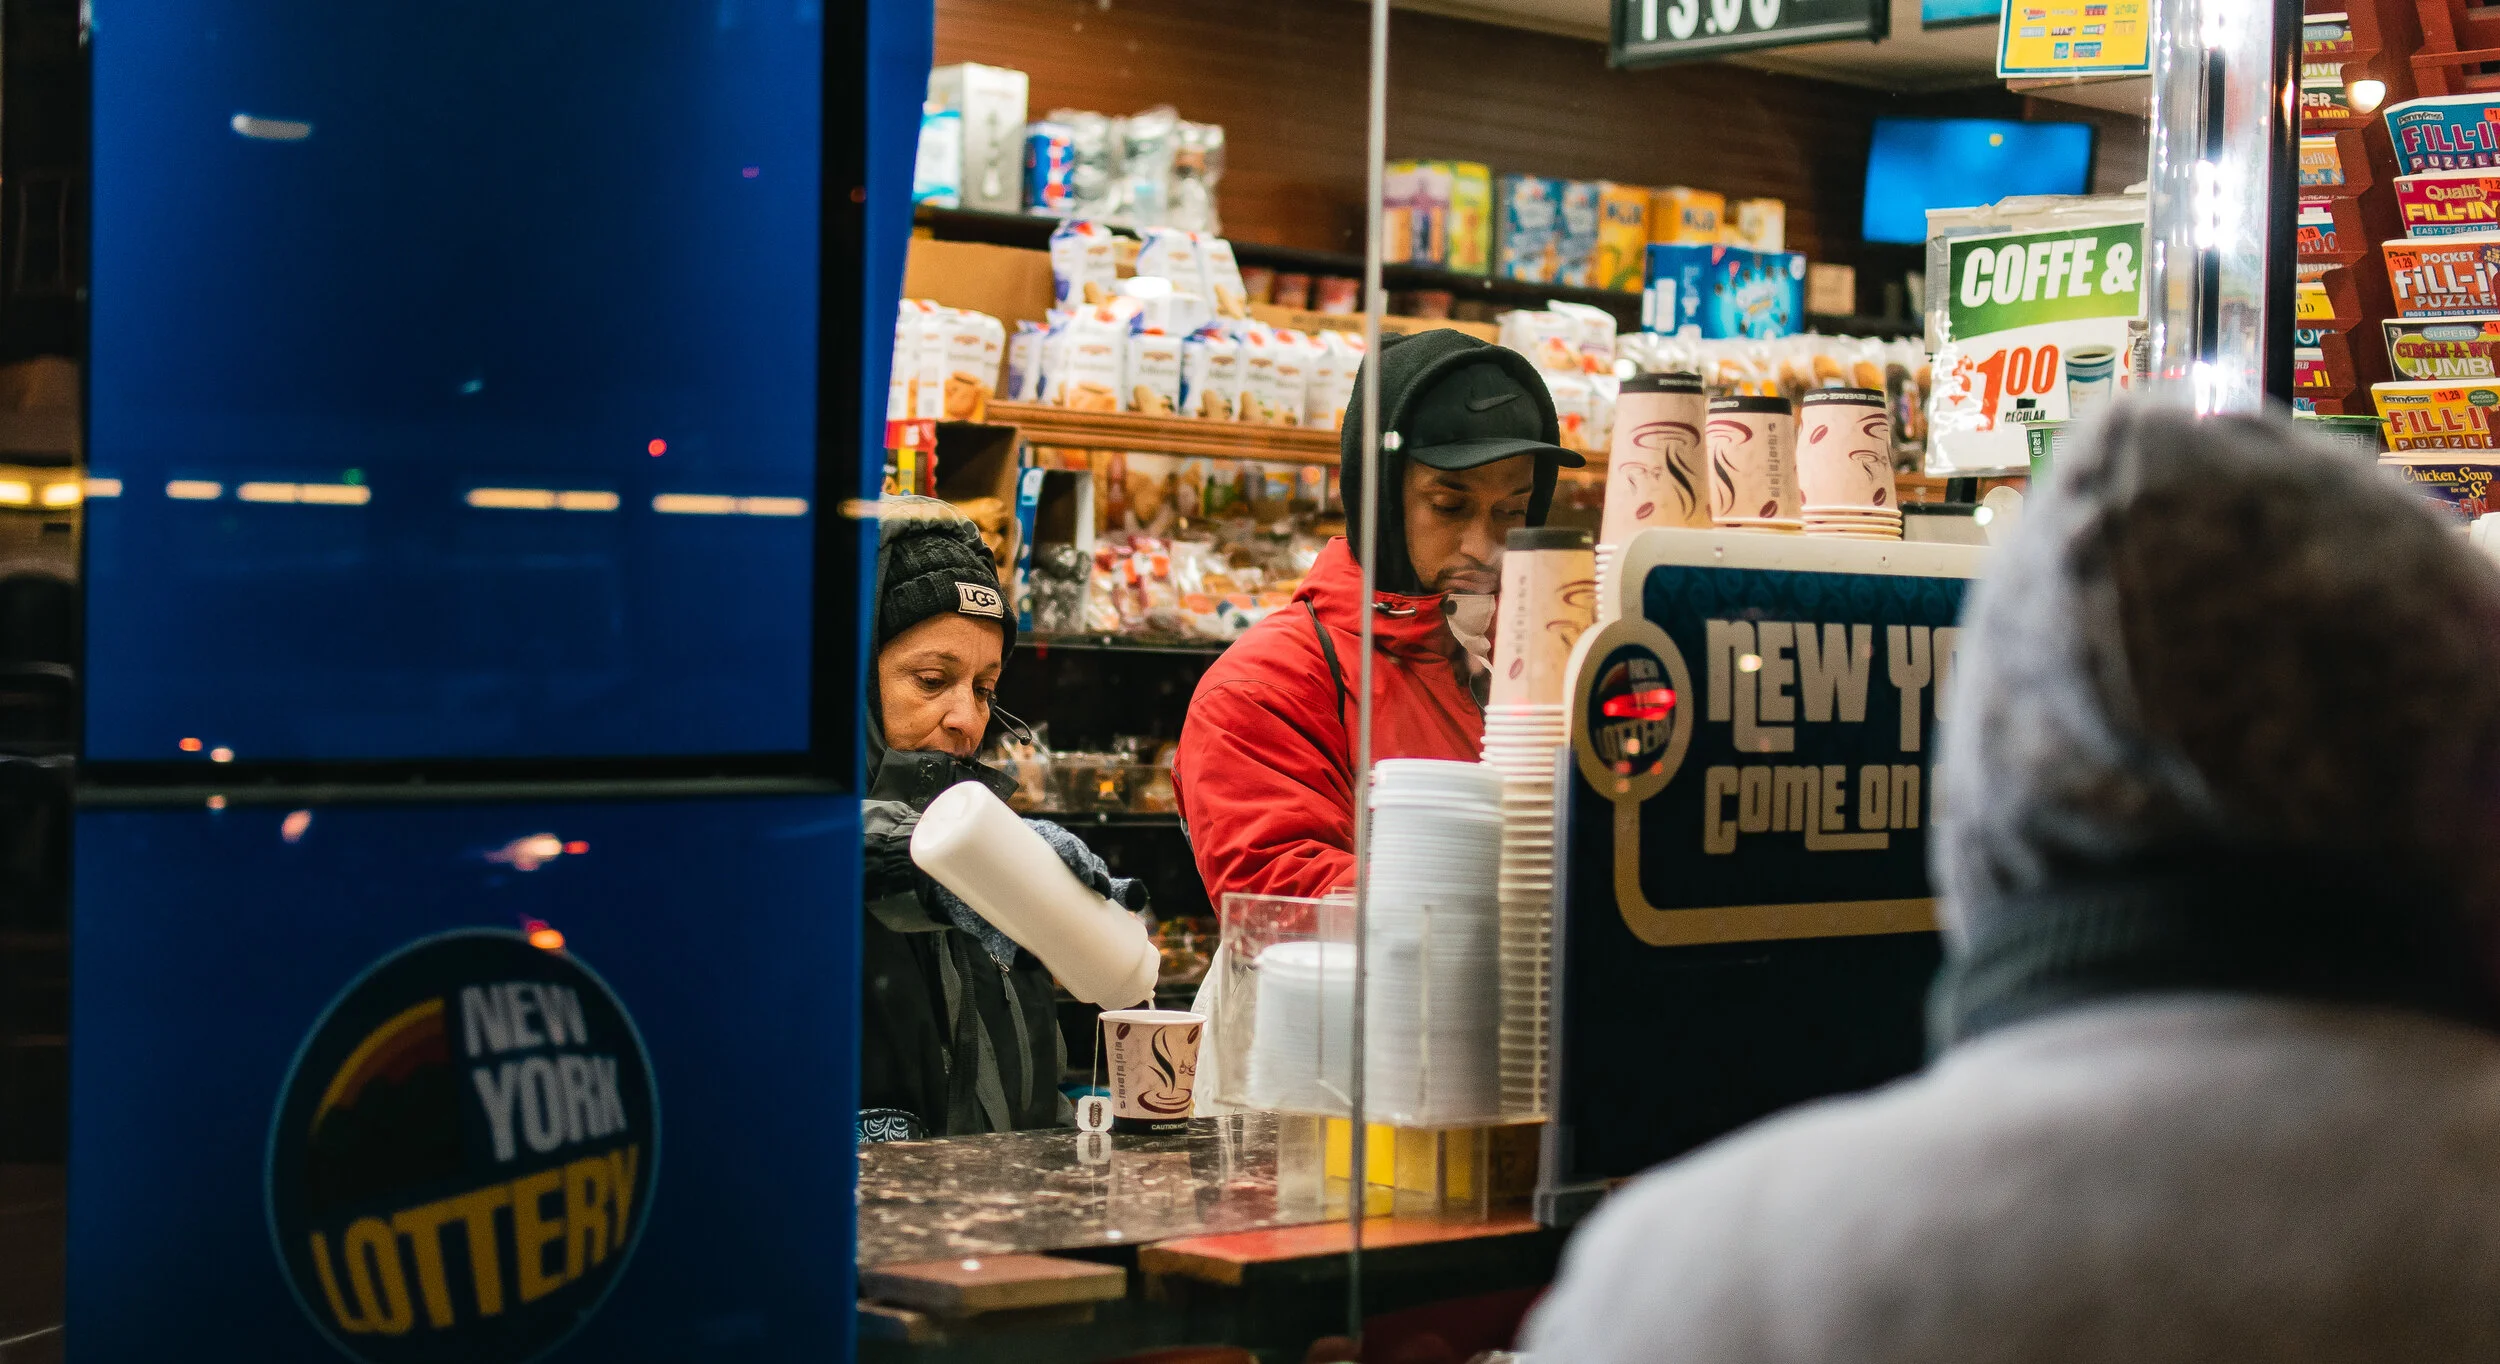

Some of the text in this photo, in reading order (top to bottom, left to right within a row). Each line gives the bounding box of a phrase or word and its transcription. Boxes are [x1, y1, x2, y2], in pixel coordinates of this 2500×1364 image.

[2426, 184, 2488, 201] Quality
[2405, 200, 2498, 221] FILL-IN
[2421, 251, 2474, 263] POCKET
[1960, 237, 2138, 308] COFFE &
[2424, 328, 2477, 338] SUPERB
[2438, 390, 2460, 401] $1.29
[2005, 410, 2046, 422] REGULAR
[2401, 465, 2493, 485] Chicken Soup
[964, 588, 996, 607] UGG
[1705, 618, 1873, 753] NEW
[1704, 764, 1889, 855] COME
[1859, 764, 1920, 830] ON
[459, 981, 589, 1058] NEW
[472, 1054, 627, 1162] YORK
[310, 1143, 640, 1335] LOTTERY
